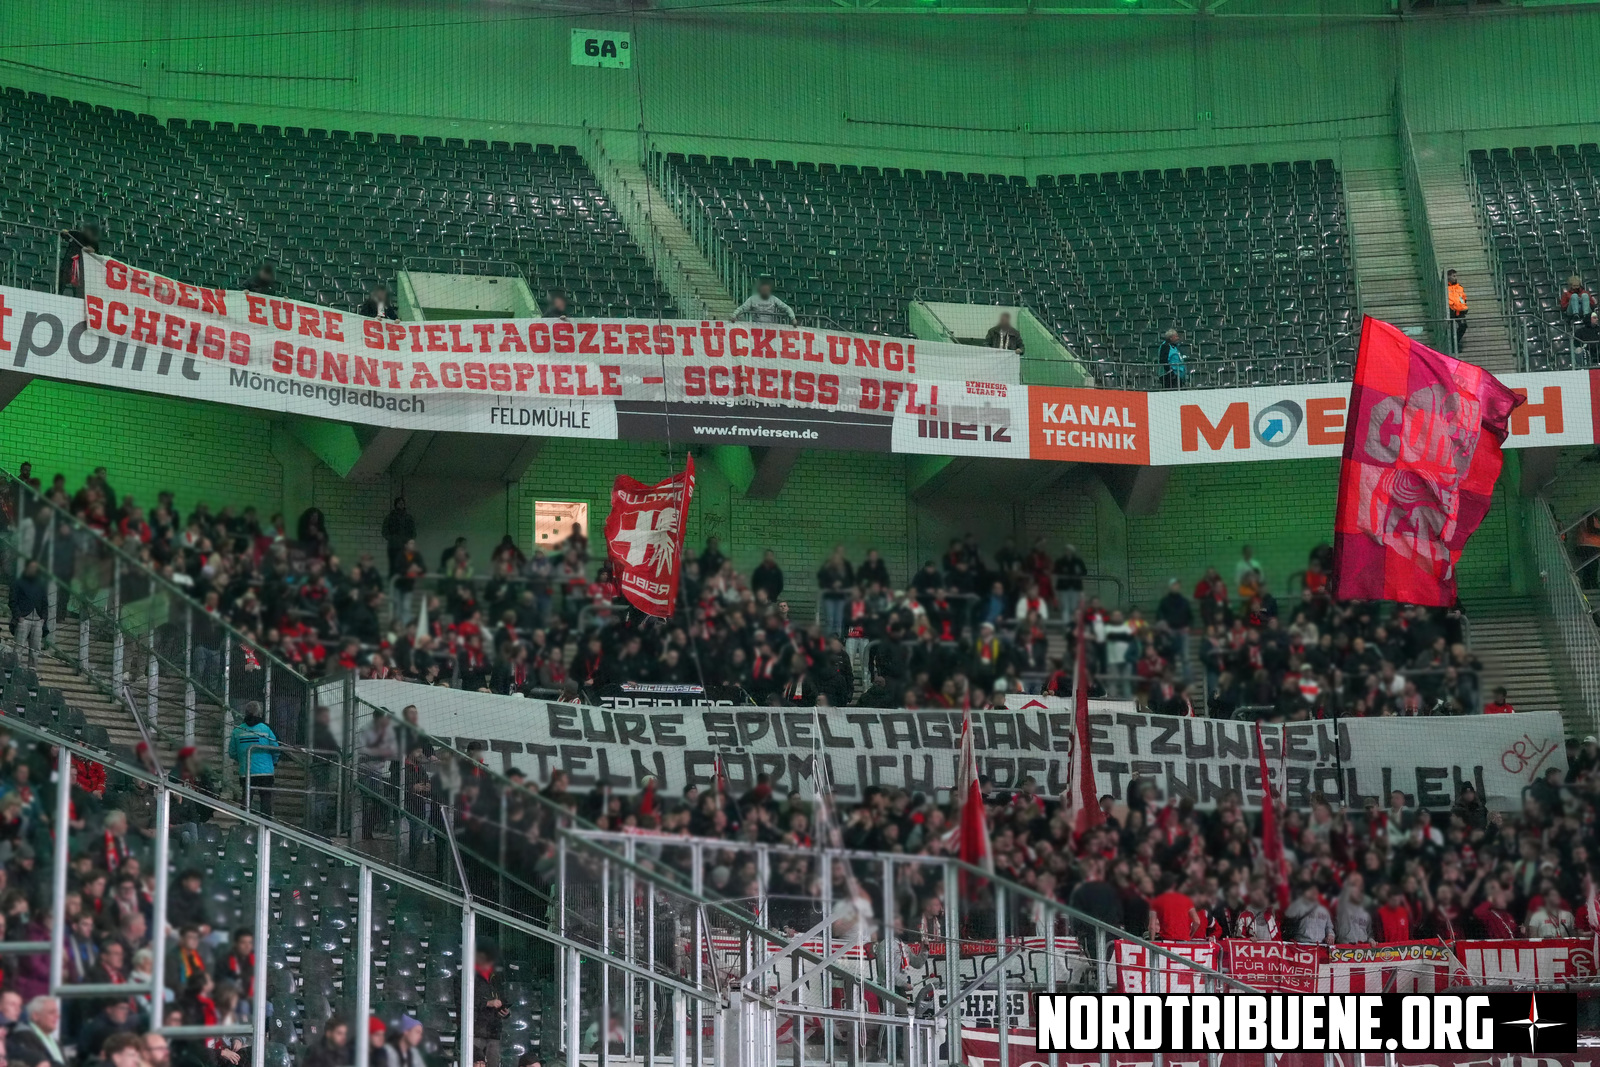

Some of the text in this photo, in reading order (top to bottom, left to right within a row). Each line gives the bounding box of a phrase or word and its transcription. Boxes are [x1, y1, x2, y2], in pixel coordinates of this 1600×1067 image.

[585, 39, 617, 58] 6A
[104, 259, 916, 374] GEGEN EURE SPIELTAGSZERSTÜCKELUNG!
[86, 294, 251, 366] SCHEISS
[271, 340, 623, 397] SONNTAGSSPIELE
[684, 365, 840, 404] SCHEISS
[858, 377, 938, 416] DFL!
[229, 367, 425, 413] Mönchengladbach
[490, 406, 591, 429] FELDMÜHLE
[1042, 402, 1136, 428] KANAL
[693, 425, 819, 439] www.fmviersen.de
[1042, 428, 1136, 450] TECHNIK
[547, 703, 687, 746] EURE
[430, 734, 668, 789] TTELN
[1235, 945, 1314, 964] KHALID
[1235, 959, 1313, 977] FÜR IMMER
